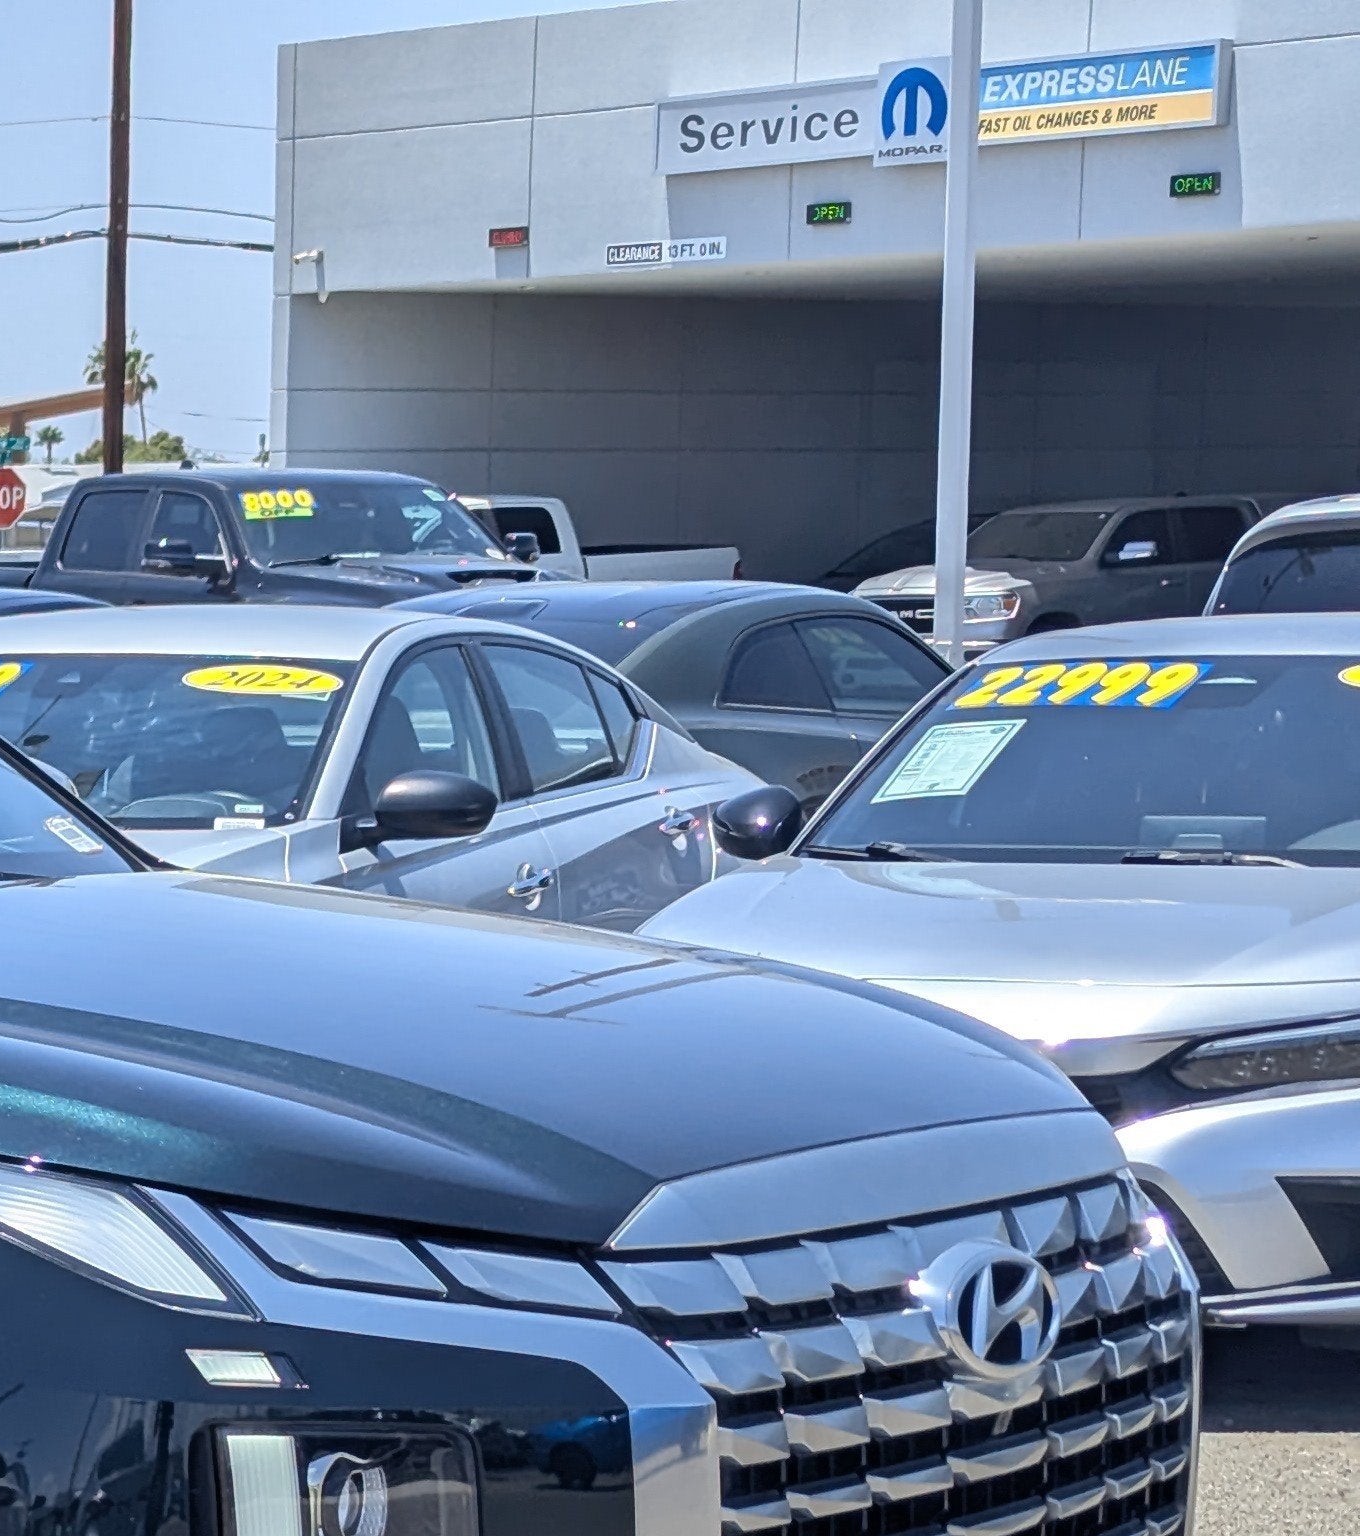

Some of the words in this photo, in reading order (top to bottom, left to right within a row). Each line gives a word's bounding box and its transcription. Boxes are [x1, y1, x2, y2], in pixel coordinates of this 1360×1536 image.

[983, 56, 1190, 103] EXPRESSLANE
[679, 103, 860, 153] Service
[979, 116, 1010, 135] FAST
[1012, 115, 1032, 131] OIL
[1036, 108, 1098, 129] CHANGES
[1101, 108, 1112, 122] &
[1116, 103, 1158, 122] MORE
[878, 145, 943, 158] MOPAR
[1174, 175, 1213, 193] OPEN
[608, 245, 661, 263] CLEARANCE
[667, 244, 678, 258] 13
[680, 243, 696, 257] FT.
[242, 489, 314, 512] 8000
[211, 669, 322, 690] 2024
[953, 661, 1199, 707] 22999
